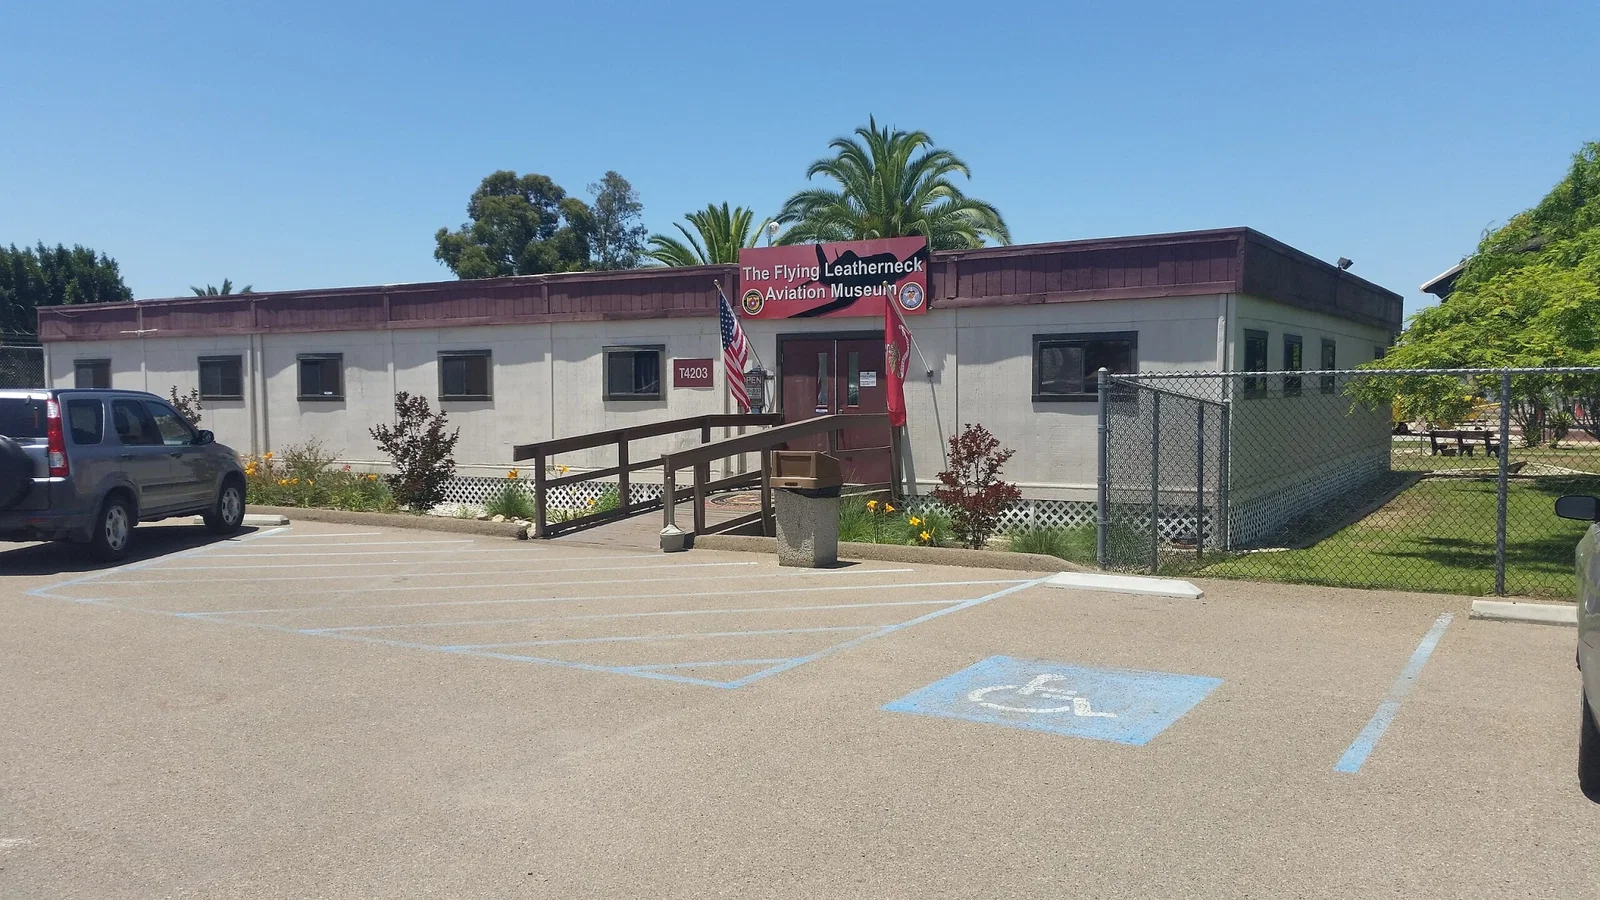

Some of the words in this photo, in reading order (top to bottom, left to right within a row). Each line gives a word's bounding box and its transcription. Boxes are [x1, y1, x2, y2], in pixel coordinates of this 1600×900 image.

[742, 266, 770, 281] The
[774, 263, 820, 283] Flying
[825, 256, 923, 277] Leatherneck
[765, 285, 826, 301] Aviation
[831, 282, 897, 299] Museum
[678, 367, 708, 379] T4203
[745, 376, 762, 384] PEN
